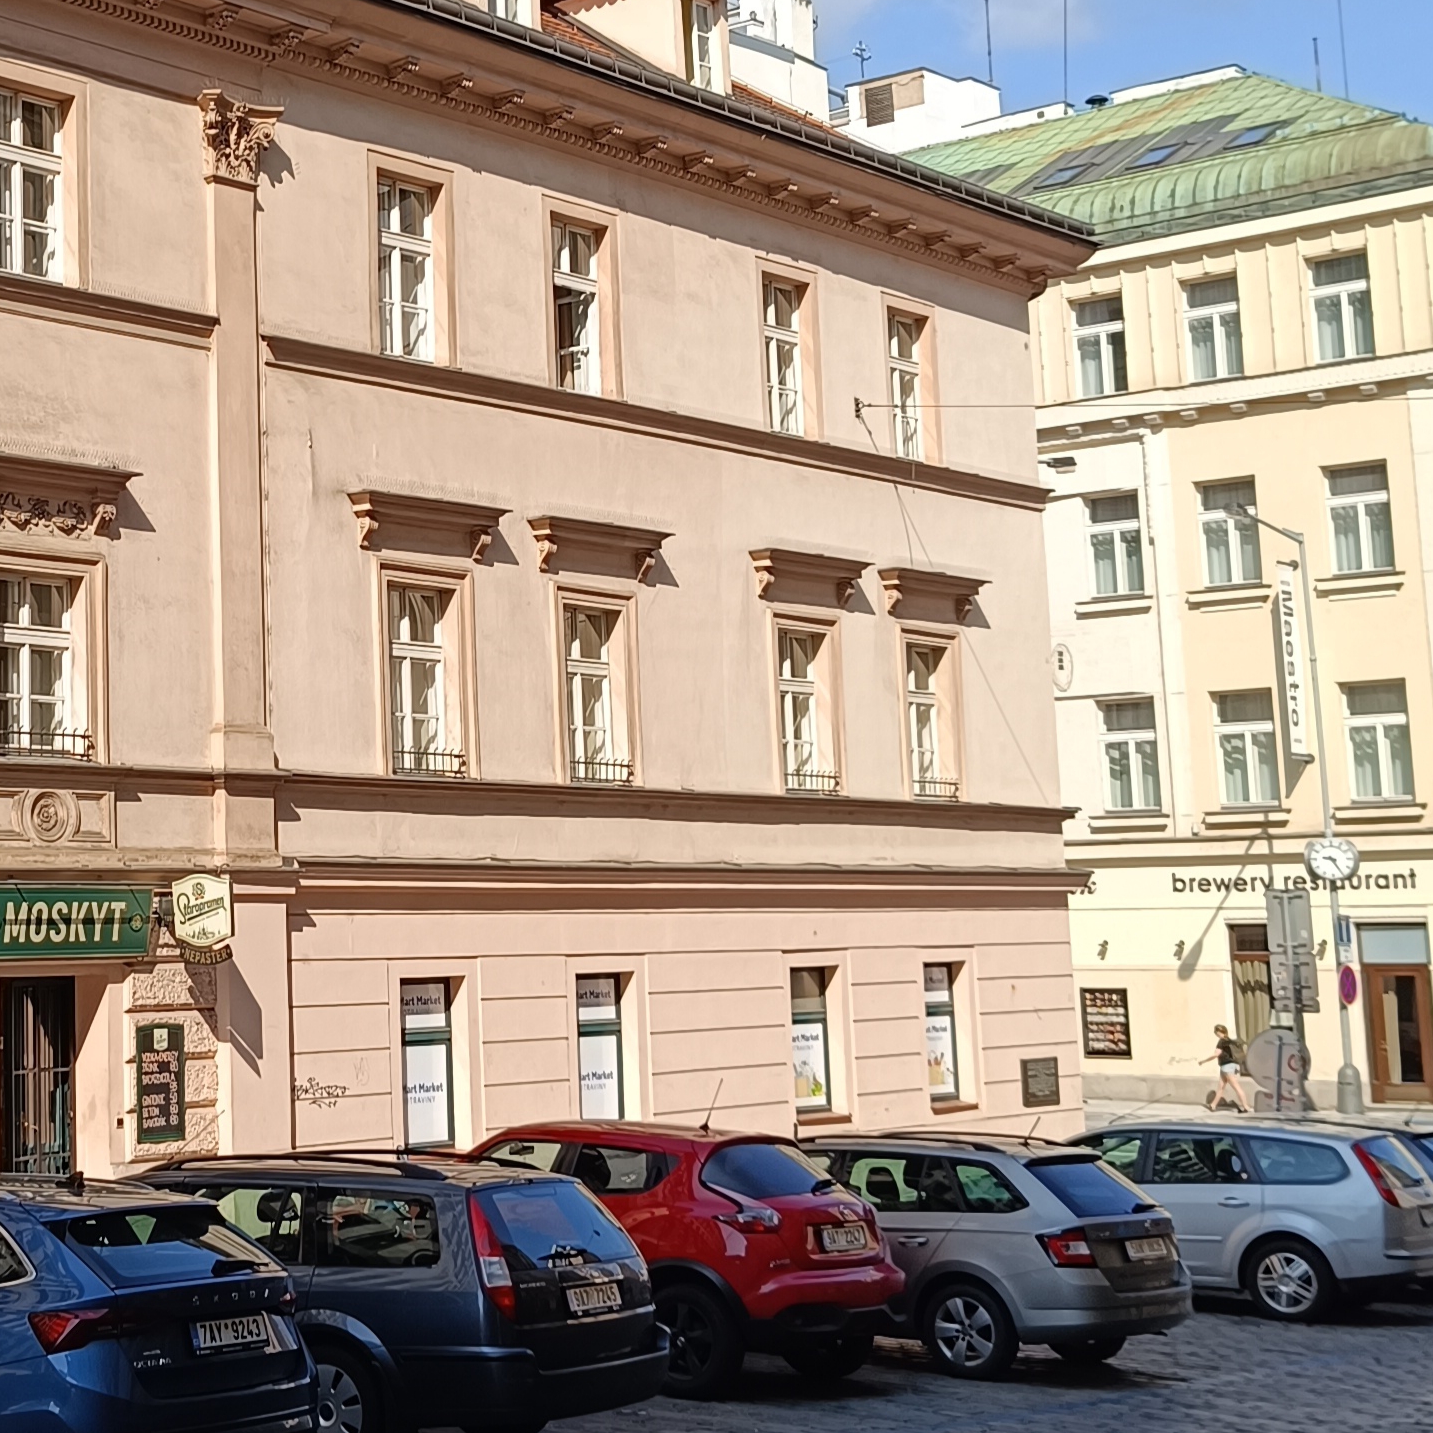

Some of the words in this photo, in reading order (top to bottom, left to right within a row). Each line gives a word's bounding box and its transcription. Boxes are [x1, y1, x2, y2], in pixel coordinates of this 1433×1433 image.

[177, 893, 226, 925] Staropramen
[3, 901, 127, 943] MOSKYT
[184, 948, 228, 964] NEPASTER
[416, 995, 441, 1005] Market
[592, 1070, 613, 1080] Market
[419, 1082, 443, 1093] Market
[200, 1322, 223, 1346] 7AY
[233, 1318, 261, 1341] 9243
